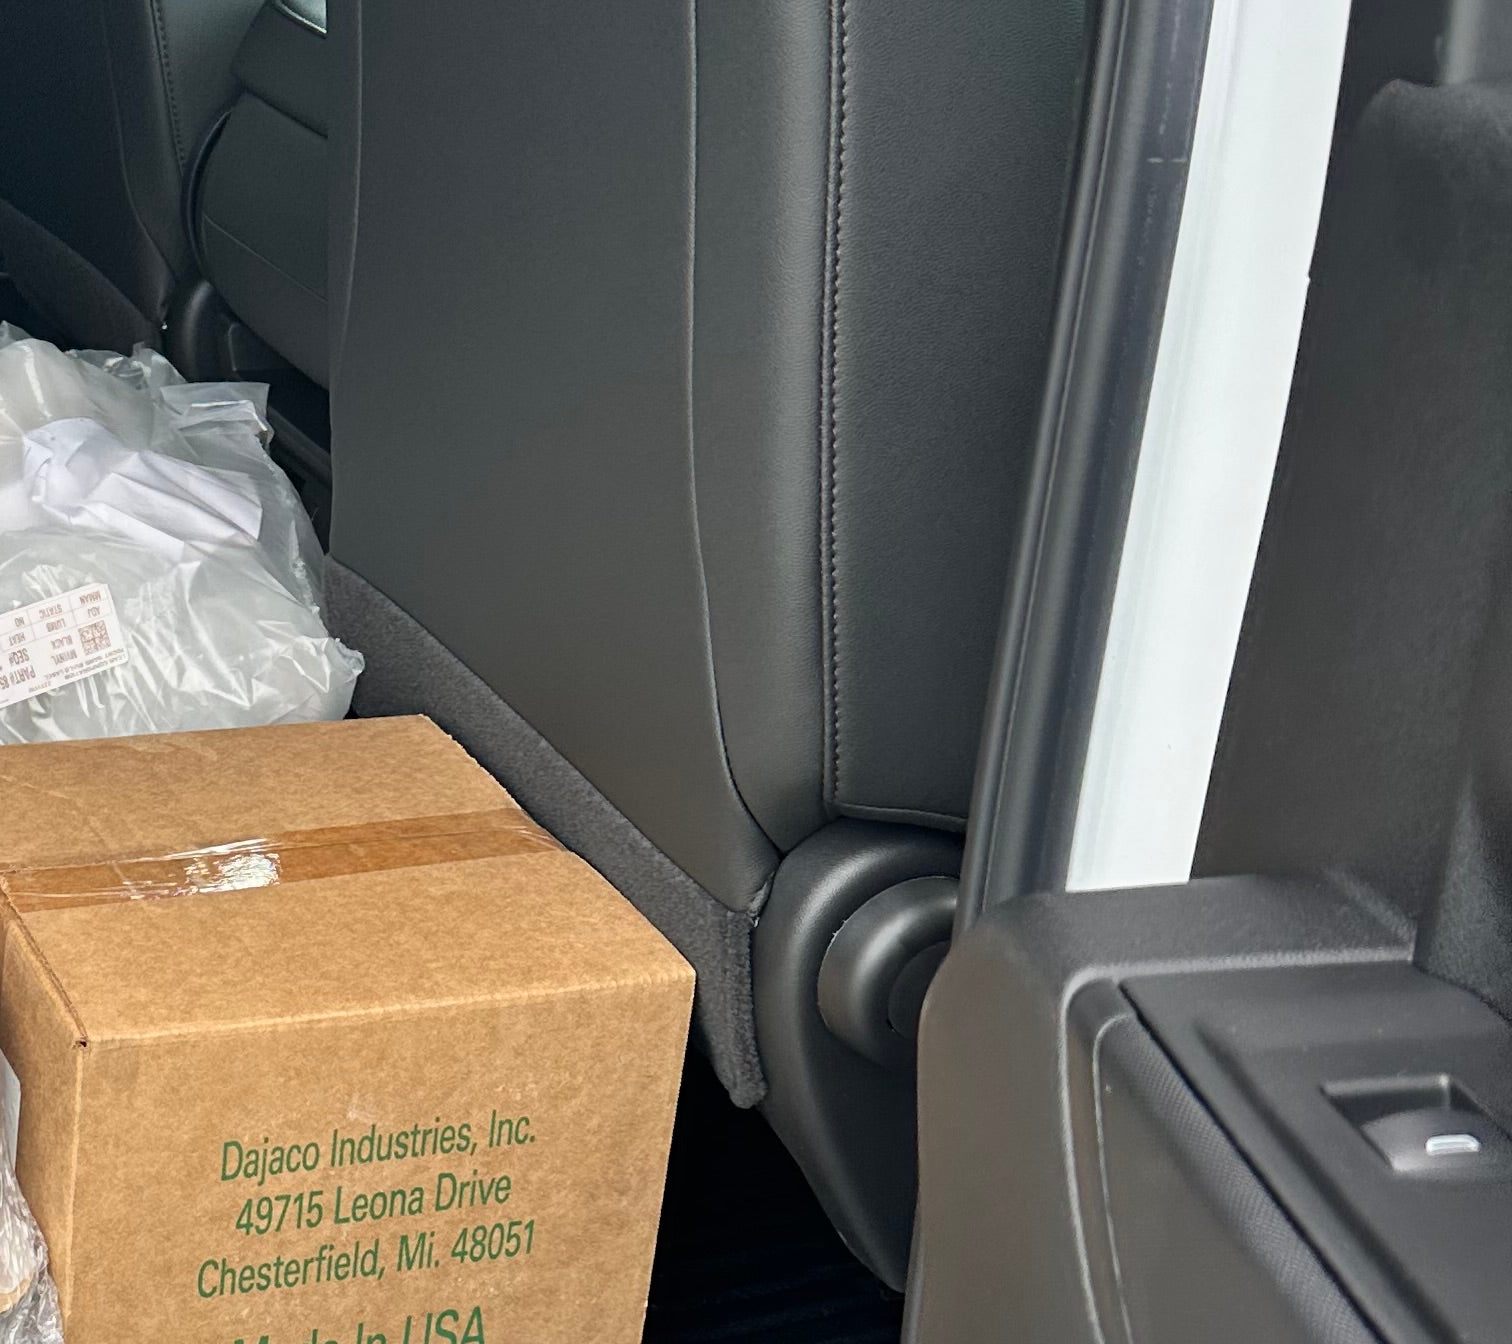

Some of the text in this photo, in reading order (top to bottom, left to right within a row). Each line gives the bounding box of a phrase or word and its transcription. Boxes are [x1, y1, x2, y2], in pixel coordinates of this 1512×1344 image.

[8, 632, 26, 646] HEAT
[220, 1109, 536, 1186] Dajaco Industries, Inc.
[235, 1169, 512, 1236] 49715 Leona Drive
[197, 1219, 536, 1300] Chesterfield, Mi. 48051
